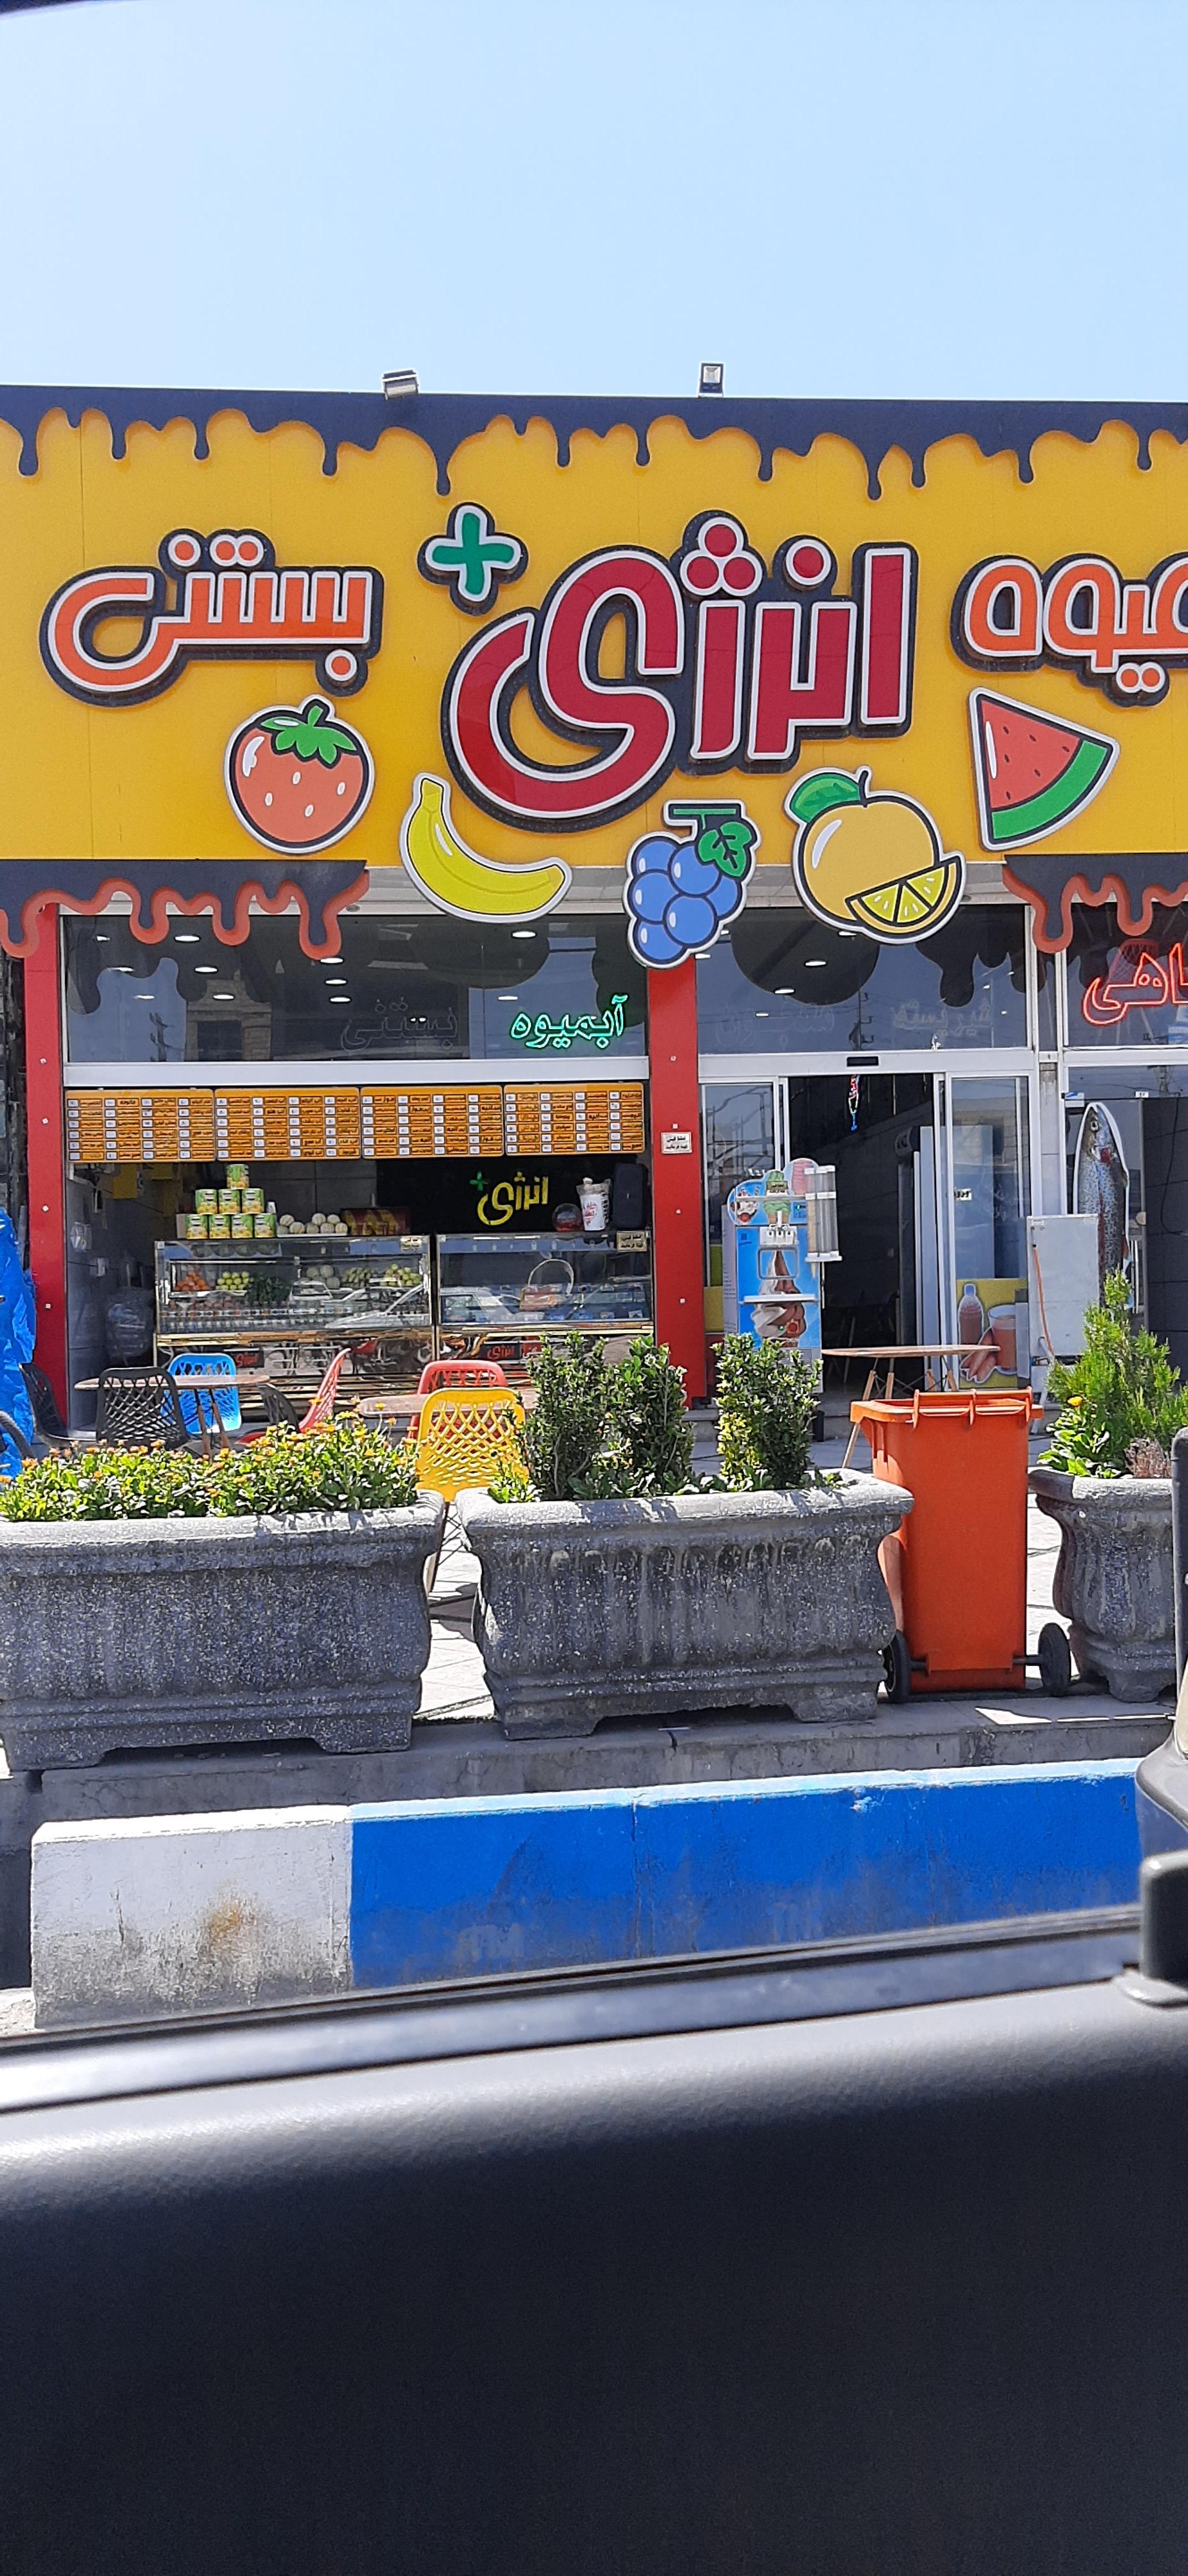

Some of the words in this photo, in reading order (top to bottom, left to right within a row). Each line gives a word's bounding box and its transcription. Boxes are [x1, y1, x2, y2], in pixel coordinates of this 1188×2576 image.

[46, 532, 374, 693] بستنی
[449, 515, 912, 820] انرژی
[1082, 942, 1188, 1027] اهی
[341, 998, 458, 1052] بستنی
[510, 994, 628, 1048] آبمیوه
[477, 1171, 548, 1226] انرژی
